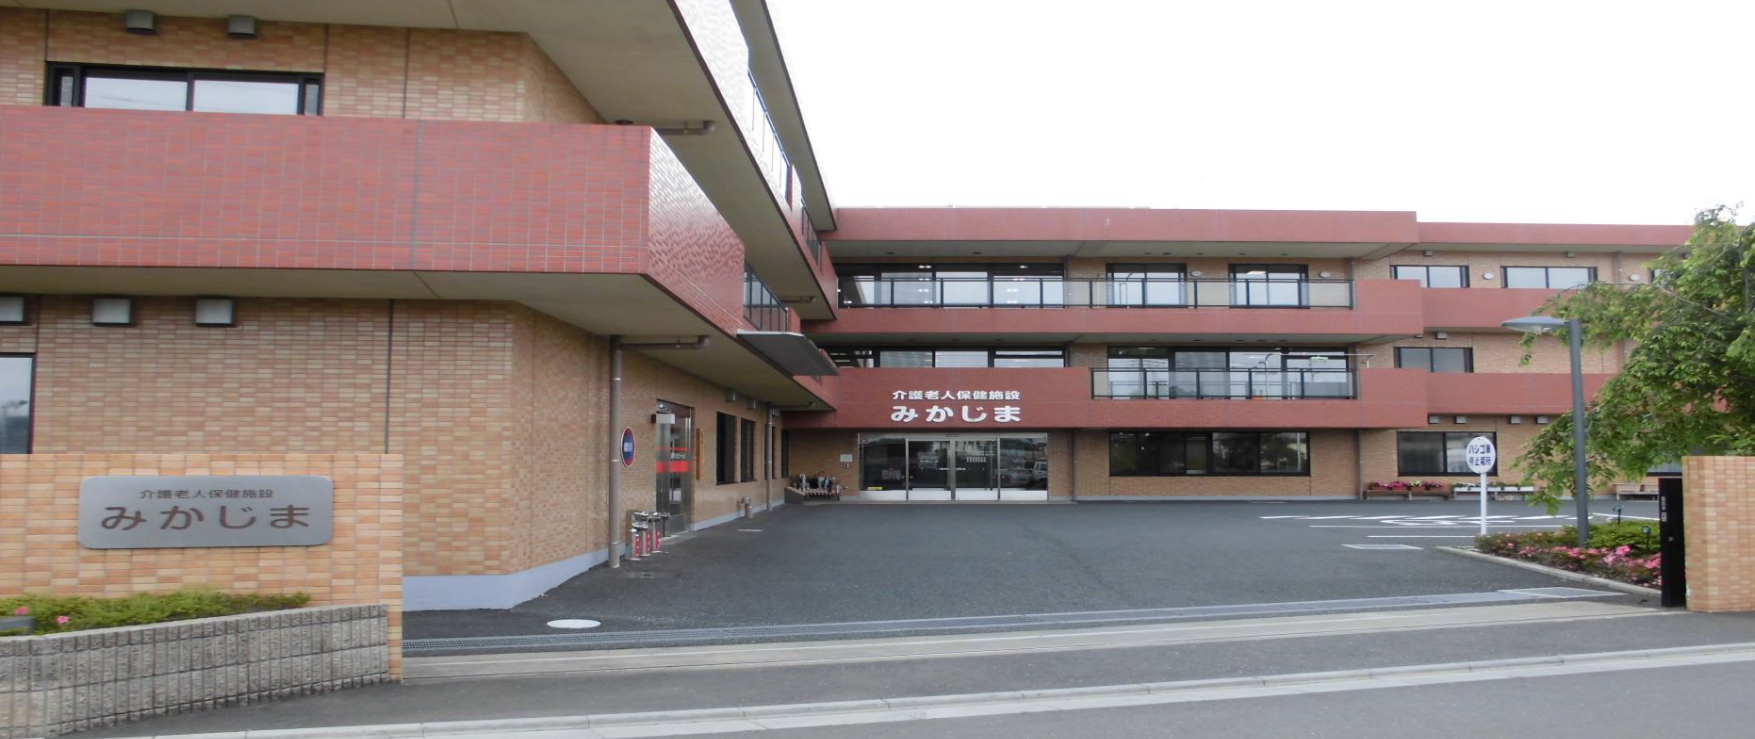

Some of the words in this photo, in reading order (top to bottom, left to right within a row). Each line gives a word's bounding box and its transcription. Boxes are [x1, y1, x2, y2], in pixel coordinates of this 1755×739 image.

[892, 390, 1020, 400] 介護老人保健施設
[891, 405, 1021, 423] みかじま
[139, 489, 274, 499] 介護老人保健施設
[101, 504, 311, 531] みかじま
